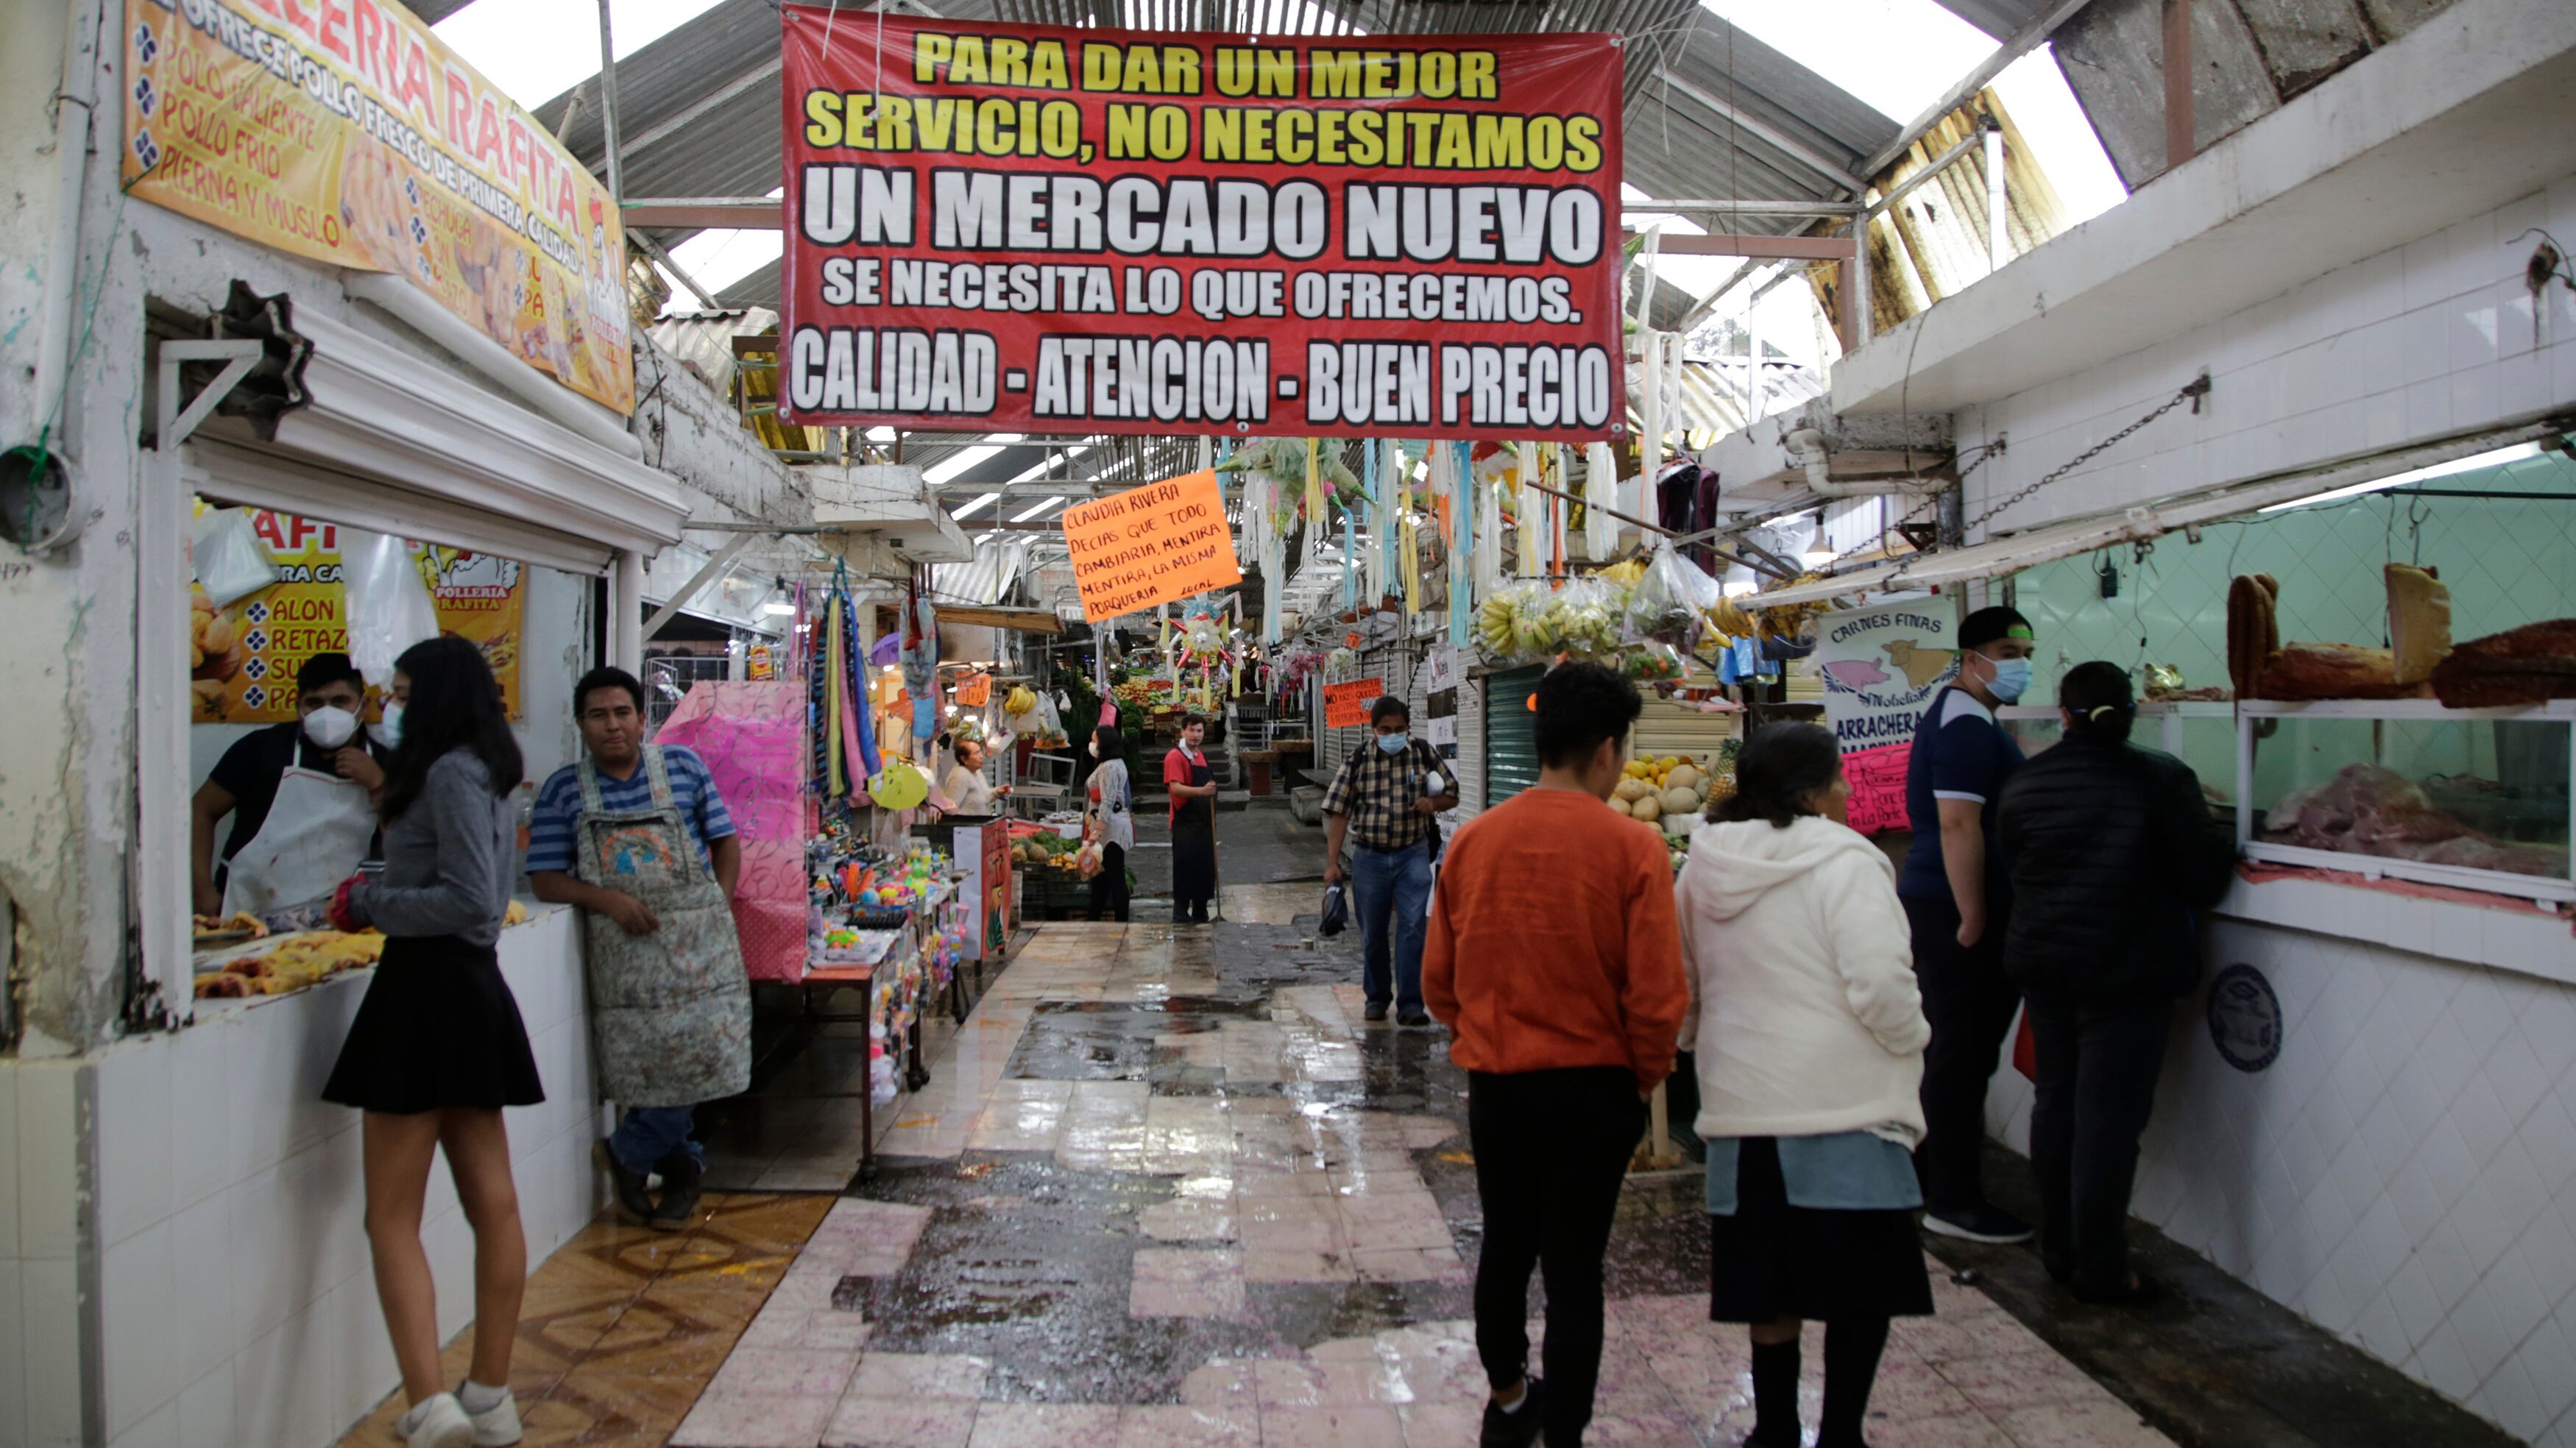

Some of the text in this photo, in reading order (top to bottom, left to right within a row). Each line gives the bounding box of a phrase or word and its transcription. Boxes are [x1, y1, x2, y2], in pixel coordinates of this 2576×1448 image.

[915, 32, 1498, 100] PARA DAR UN MEJOR
[162, 90, 228, 157] POLLO
[804, 89, 1602, 171] SERVICIO, NO NECESITAMOS
[288, 43, 363, 126] POLLO
[363, 93, 432, 174] FRESCO
[432, 146, 459, 192] DE
[458, 165, 526, 238] PRIMERA
[527, 210, 579, 275] CALIDAD
[445, 65, 583, 241] RAFITA
[160, 143, 339, 249] PIERNA Y MUSLO
[803, 166, 1603, 266] UN MERCADO NUEVO
[821, 256, 1583, 324] SE NECESITA LO QUE OFRECEMOS.
[789, 327, 998, 414] CALIDAD
[1033, 336, 1269, 422] ATENCION
[1306, 341, 1432, 425] BUEN
[1440, 344, 1611, 427] PRECIO
[1067, 483, 1180, 529] CLAUDIA RIVERA
[1071, 503, 1207, 554] DECIAS QUE TODO
[1076, 523, 1221, 577] CAMBIARIA, MENTIRA
[1082, 544, 1217, 596] MENTIRA, LA MISMA
[272, 599, 334, 622] ALON
[436, 586, 509, 599] POLLERIA
[441, 597, 501, 611] RAFITA
[1089, 586, 1158, 617] PORQUERIA
[271, 628, 351, 650] RETAZ
[1830, 612, 1942, 644] CARNES FINAS
[1836, 711, 1924, 741] ARRACHERA
